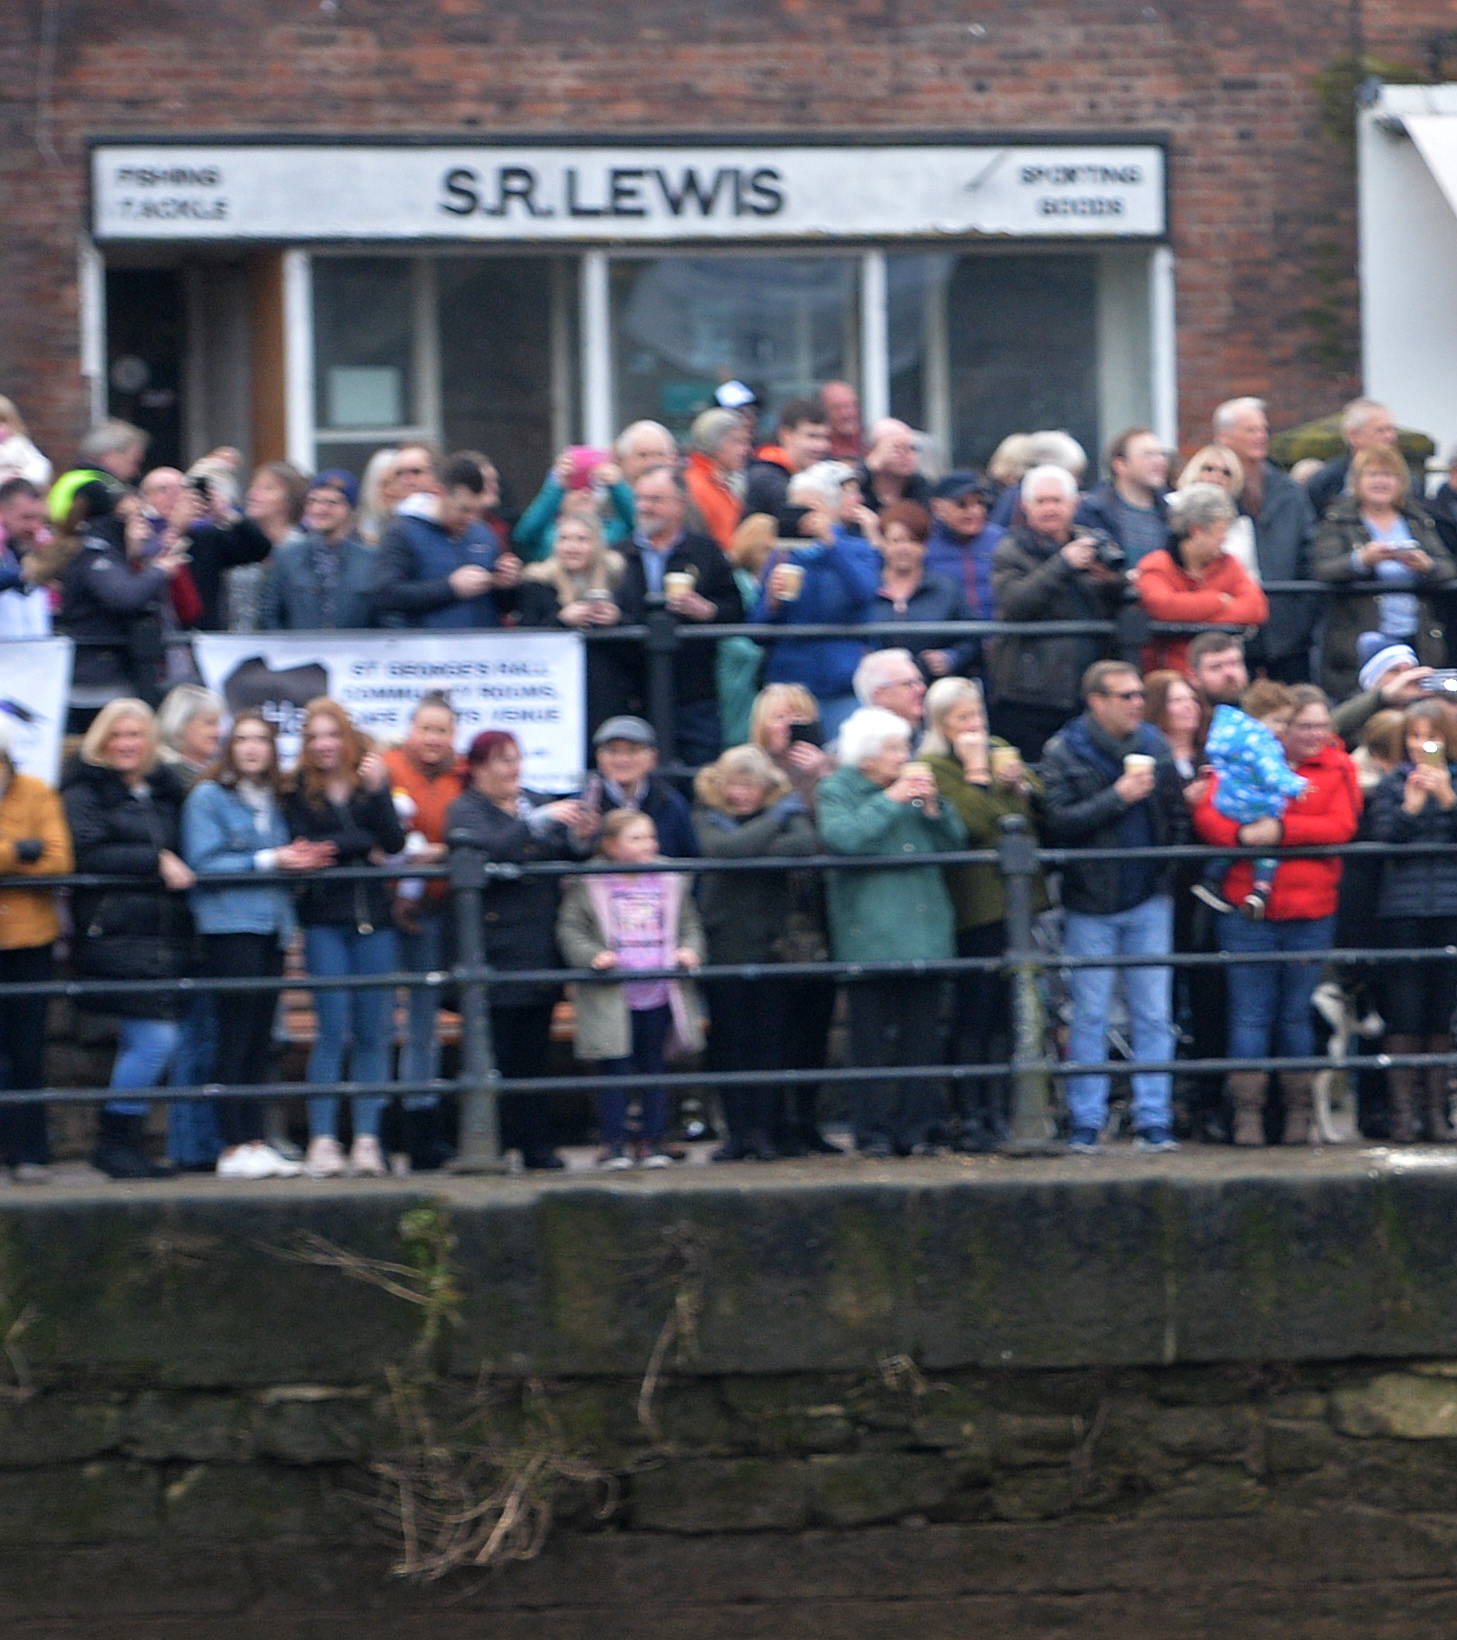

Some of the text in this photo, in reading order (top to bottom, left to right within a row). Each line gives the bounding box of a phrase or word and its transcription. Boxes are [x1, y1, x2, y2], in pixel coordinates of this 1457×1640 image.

[115, 165, 221, 187] FISHING
[1020, 164, 1142, 186] SPORTING
[567, 168, 785, 218] LEWIS
[117, 196, 228, 221] TACKLE
[1041, 196, 1123, 217] GOODS
